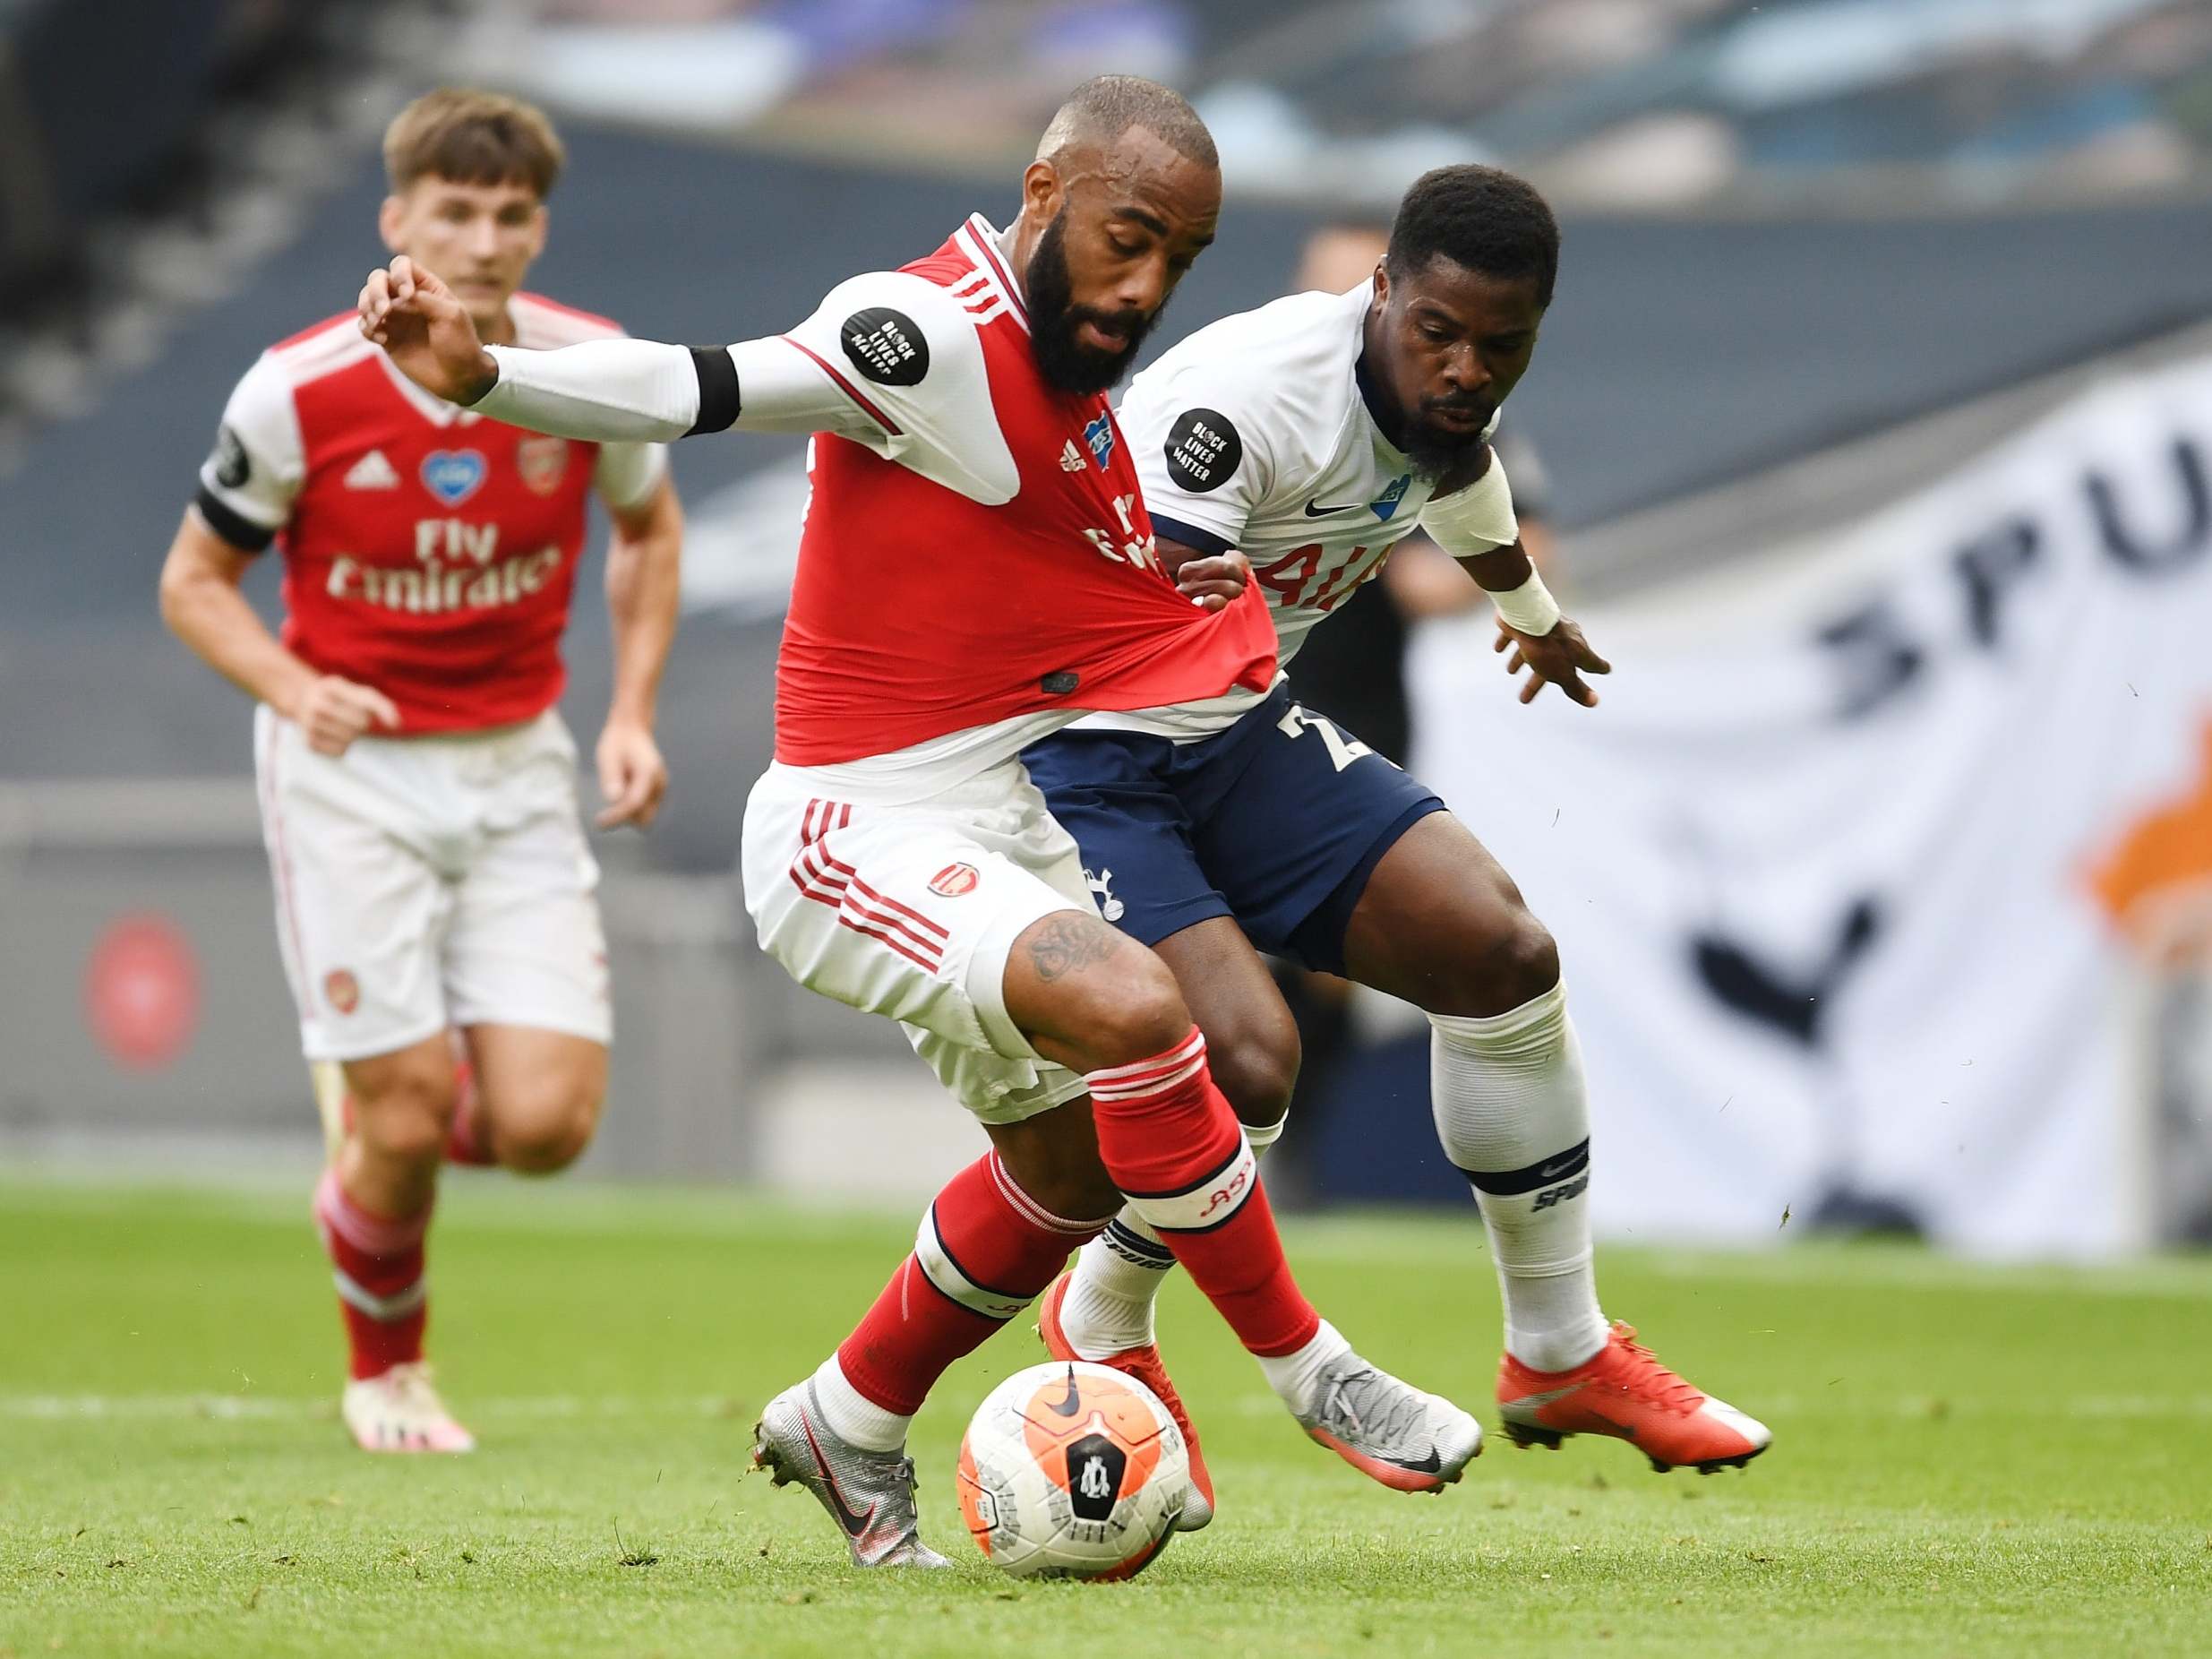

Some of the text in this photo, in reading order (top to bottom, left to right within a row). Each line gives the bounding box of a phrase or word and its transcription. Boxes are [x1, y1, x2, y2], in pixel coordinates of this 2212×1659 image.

[868, 331, 900, 366] LIVES
[1172, 446, 1211, 481] MATTER
[1184, 436, 1215, 464] LIVES
